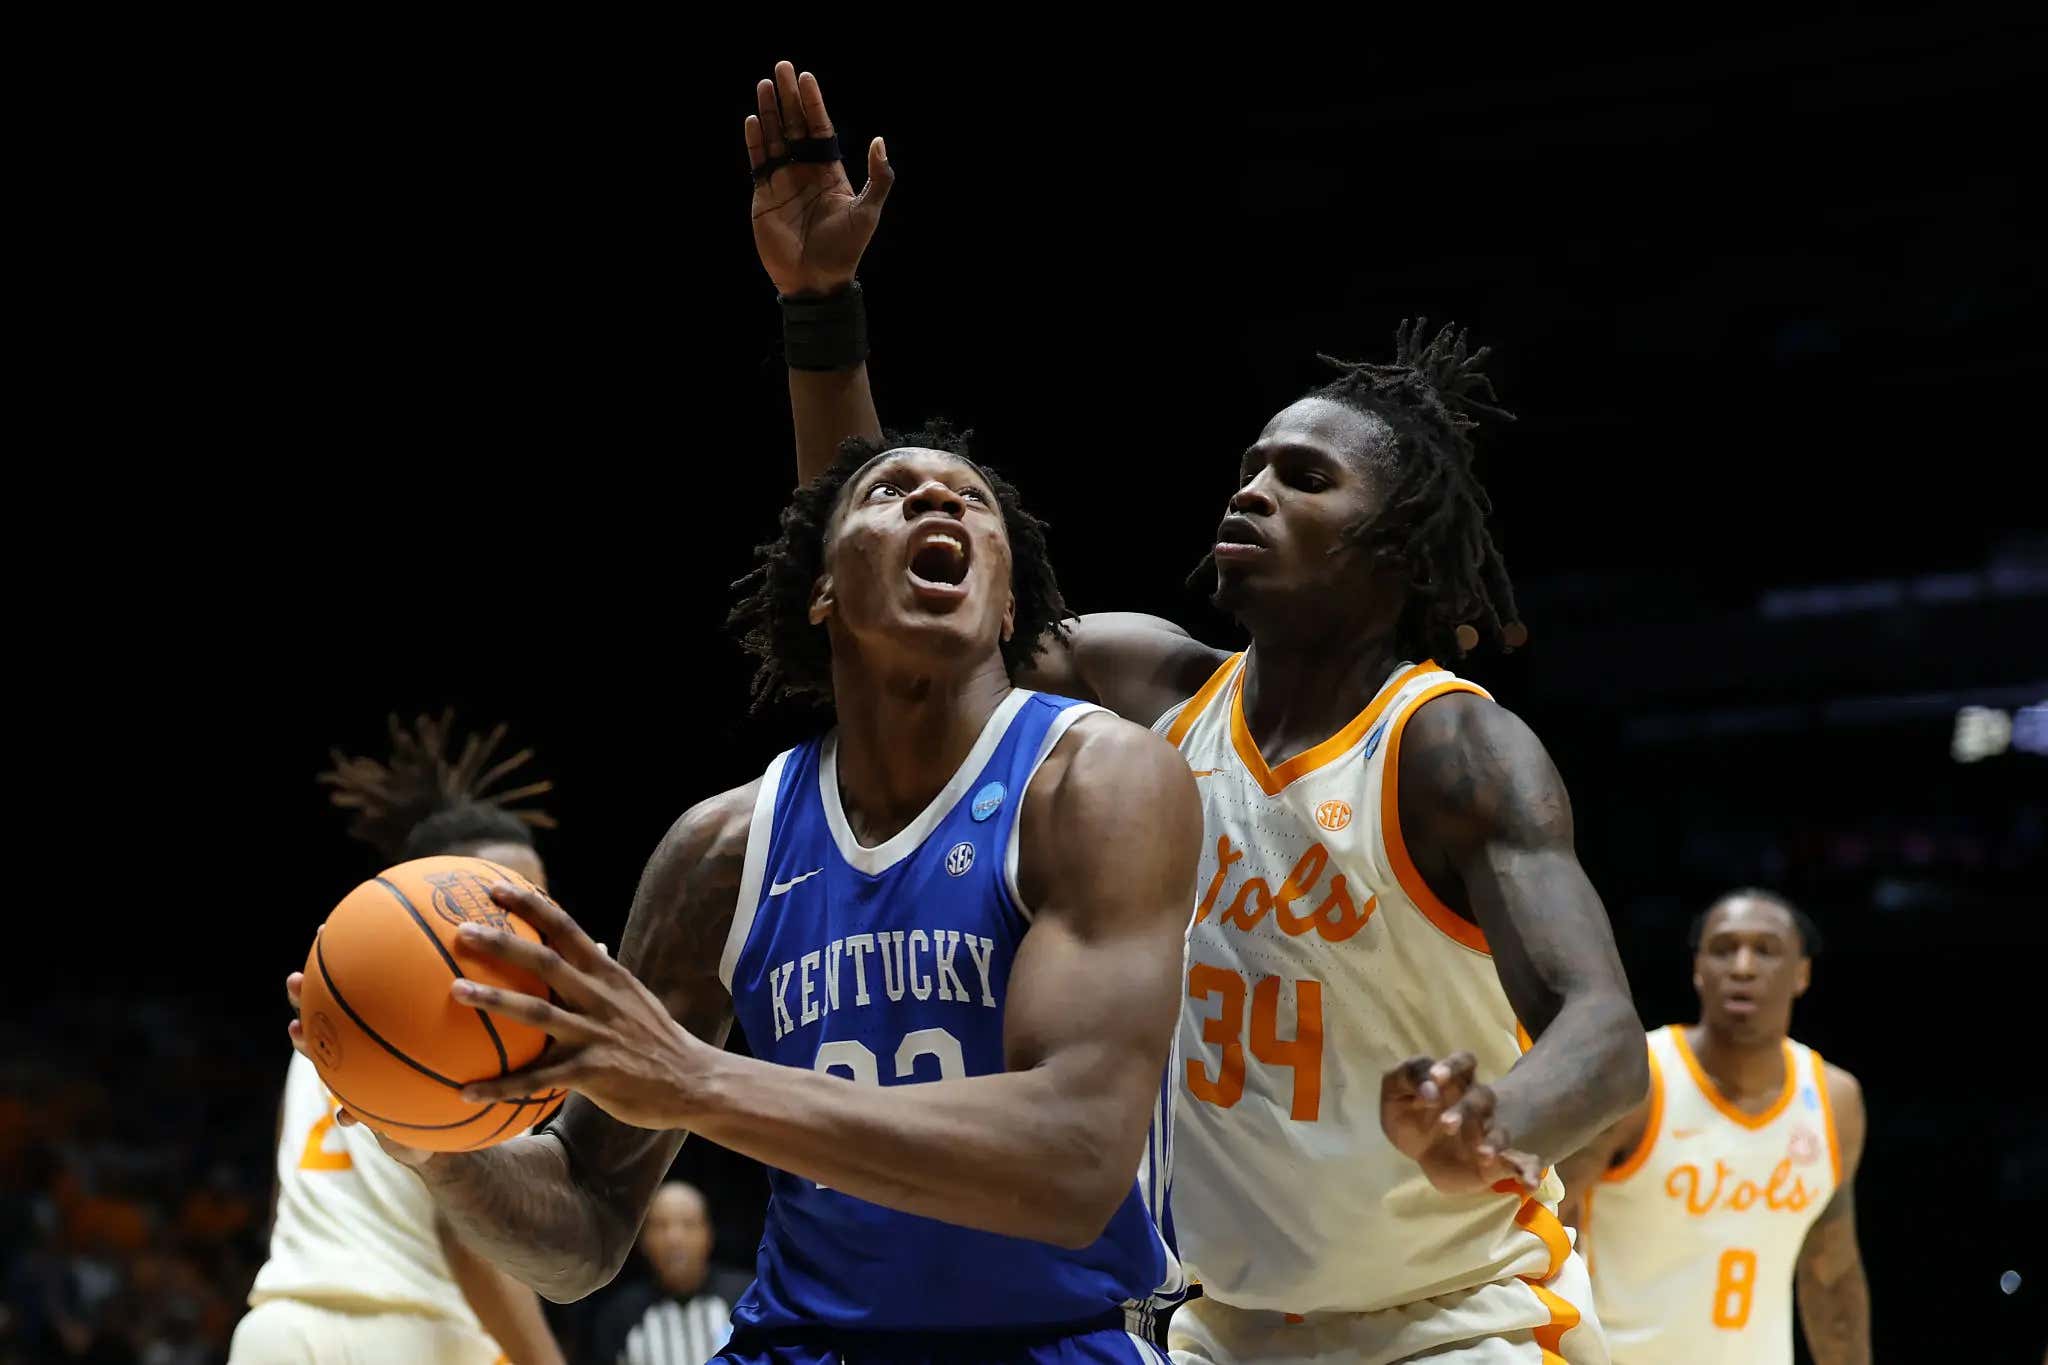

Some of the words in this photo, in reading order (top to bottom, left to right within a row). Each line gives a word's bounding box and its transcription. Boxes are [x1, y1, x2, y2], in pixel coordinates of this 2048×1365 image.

[1318, 801, 1350, 829] SEC
[948, 844, 974, 875] SEC
[769, 929, 997, 1042] KENTUCKY
[1186, 962, 1323, 1122] 34
[1665, 1159, 1819, 1217] Vols
[1712, 1247, 1757, 1331] 8
